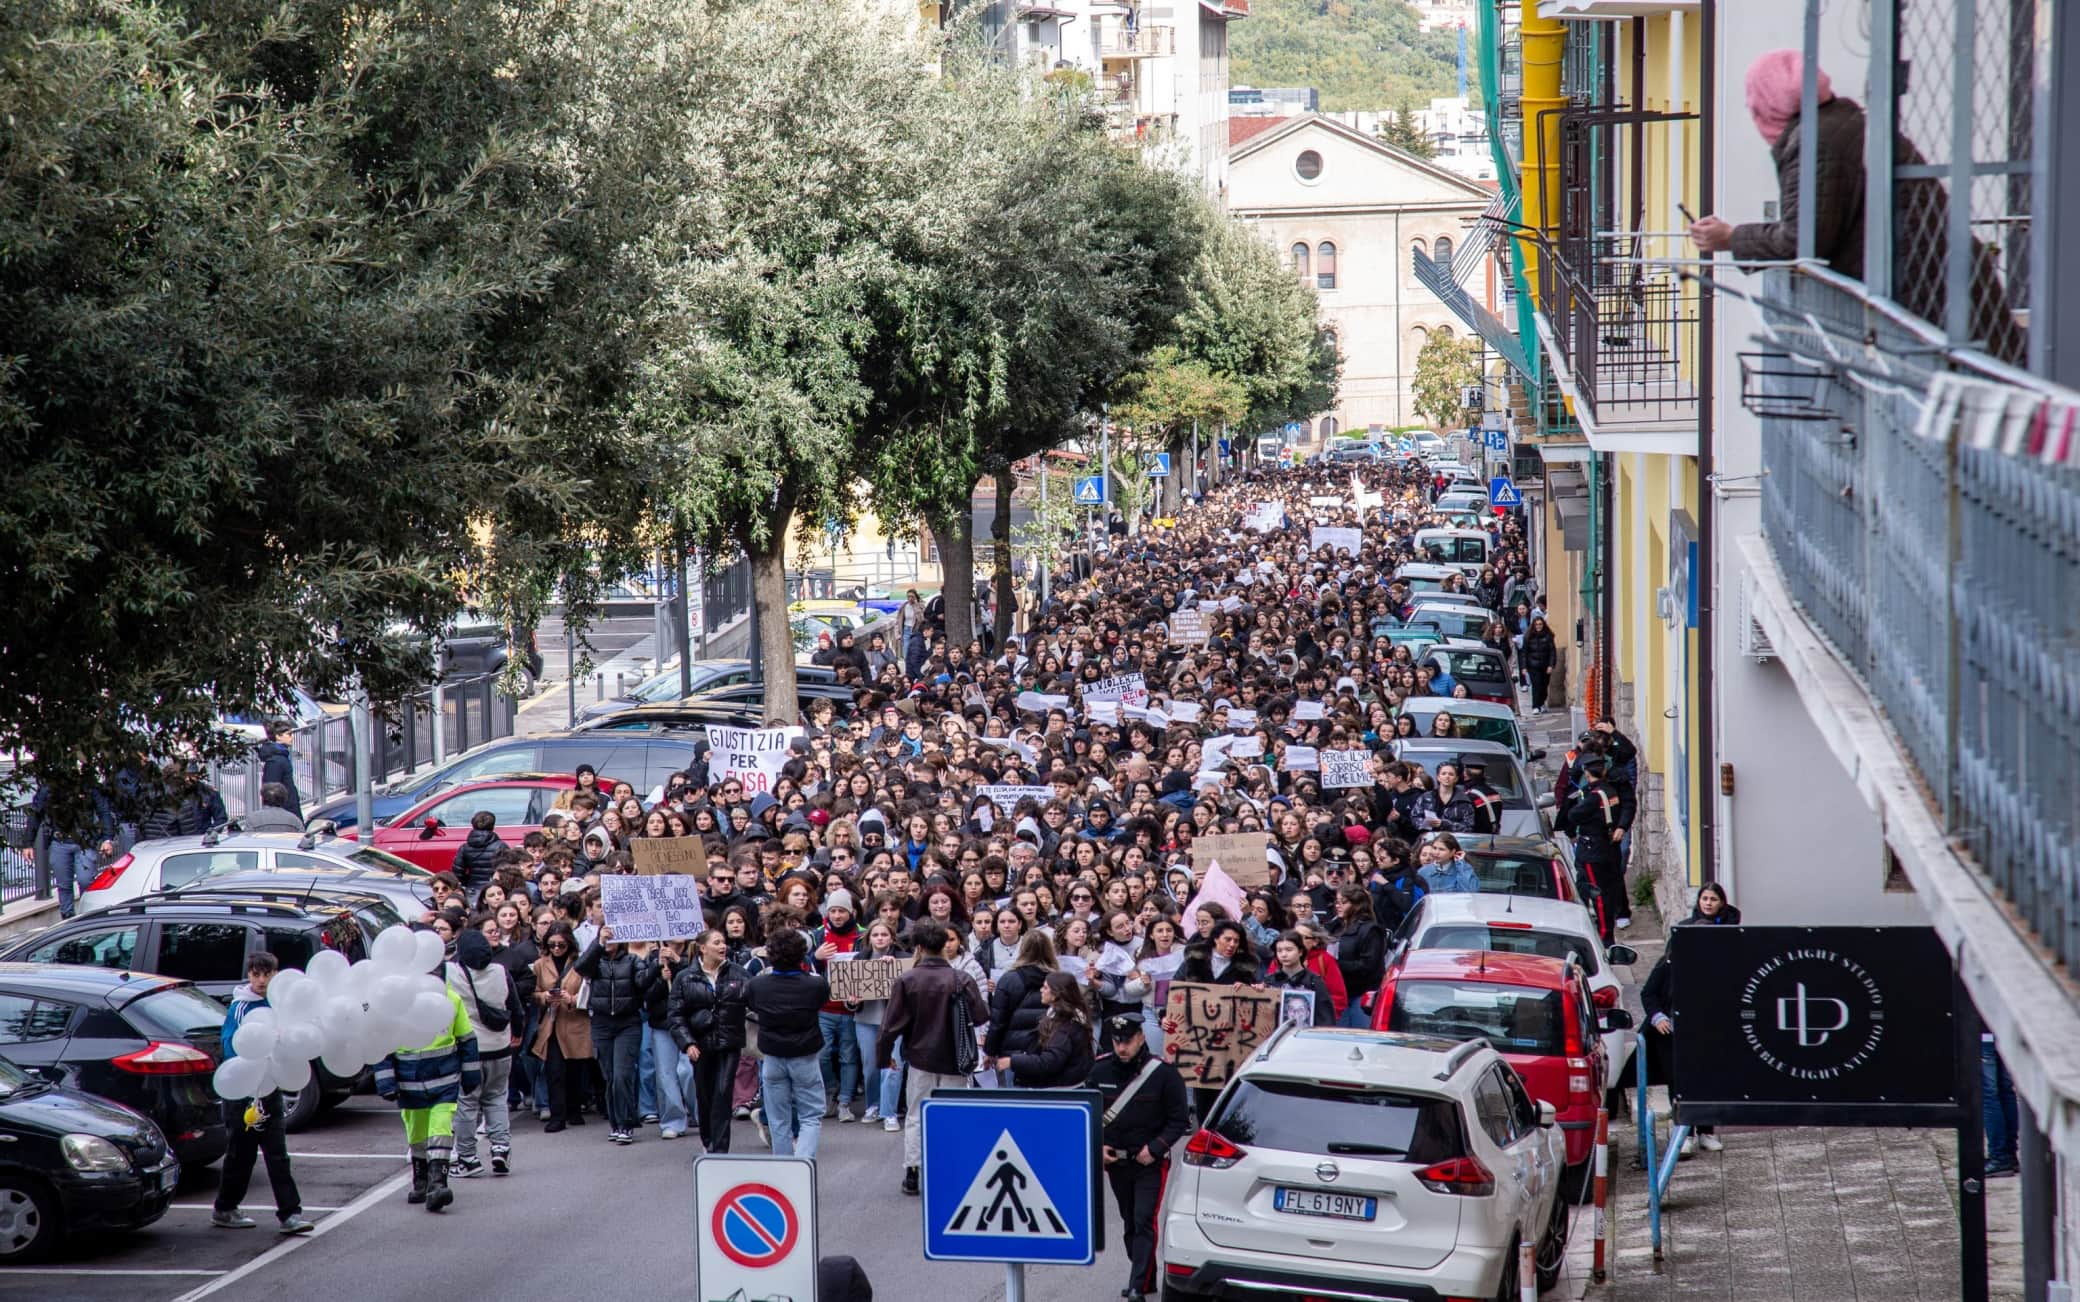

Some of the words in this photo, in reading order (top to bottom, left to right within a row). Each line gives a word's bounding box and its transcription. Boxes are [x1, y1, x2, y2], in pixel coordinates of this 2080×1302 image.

[1489, 433, 1498, 444] P
[1496, 439, 1504, 449] P
[1082, 685, 1094, 694] LA
[1096, 674, 1142, 689] VIOLENZA
[710, 729, 784, 751] GIUSTIZIA
[730, 754, 758, 768] PER
[1329, 762, 1364, 774] SORRISO
[604, 901, 648, 913] QUESTA
[666, 911, 681, 921] LO
[830, 961, 850, 981] PER
[850, 960, 880, 980] ELISA
[1741, 955, 1784, 1004] DOUBLE
[1787, 949, 1838, 962] LIGHT
[1842, 958, 1883, 1004] STUDIO
[830, 980, 863, 1000] GENTE
[1187, 1025, 1258, 1054] PER
[1741, 1024, 1786, 1072] DOUBLE
[1790, 1066, 1840, 1080] LIGHT
[1844, 1025, 1884, 1072] STUDIO
[1175, 1048, 1235, 1085] ELI
[1286, 1191, 1305, 1208] FL
[1313, 1194, 1364, 1215] 619NY
